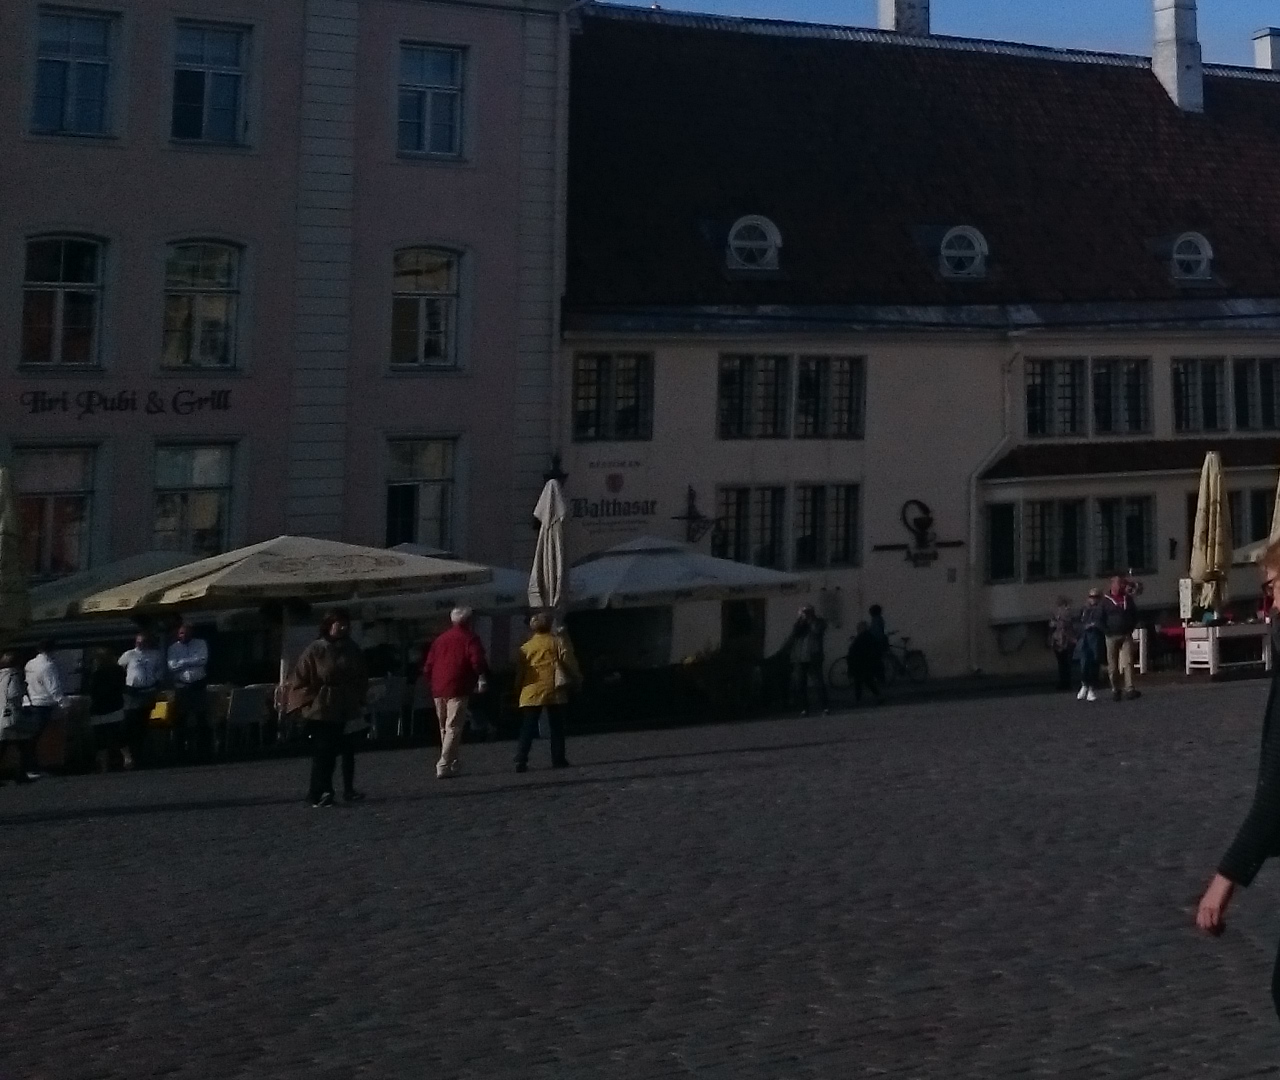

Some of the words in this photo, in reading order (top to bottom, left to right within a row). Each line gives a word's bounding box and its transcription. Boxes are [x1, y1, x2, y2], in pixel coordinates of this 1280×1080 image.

[145, 390, 165, 414] &
[172, 390, 232, 415] Grill
[570, 497, 657, 518] Balthasar
